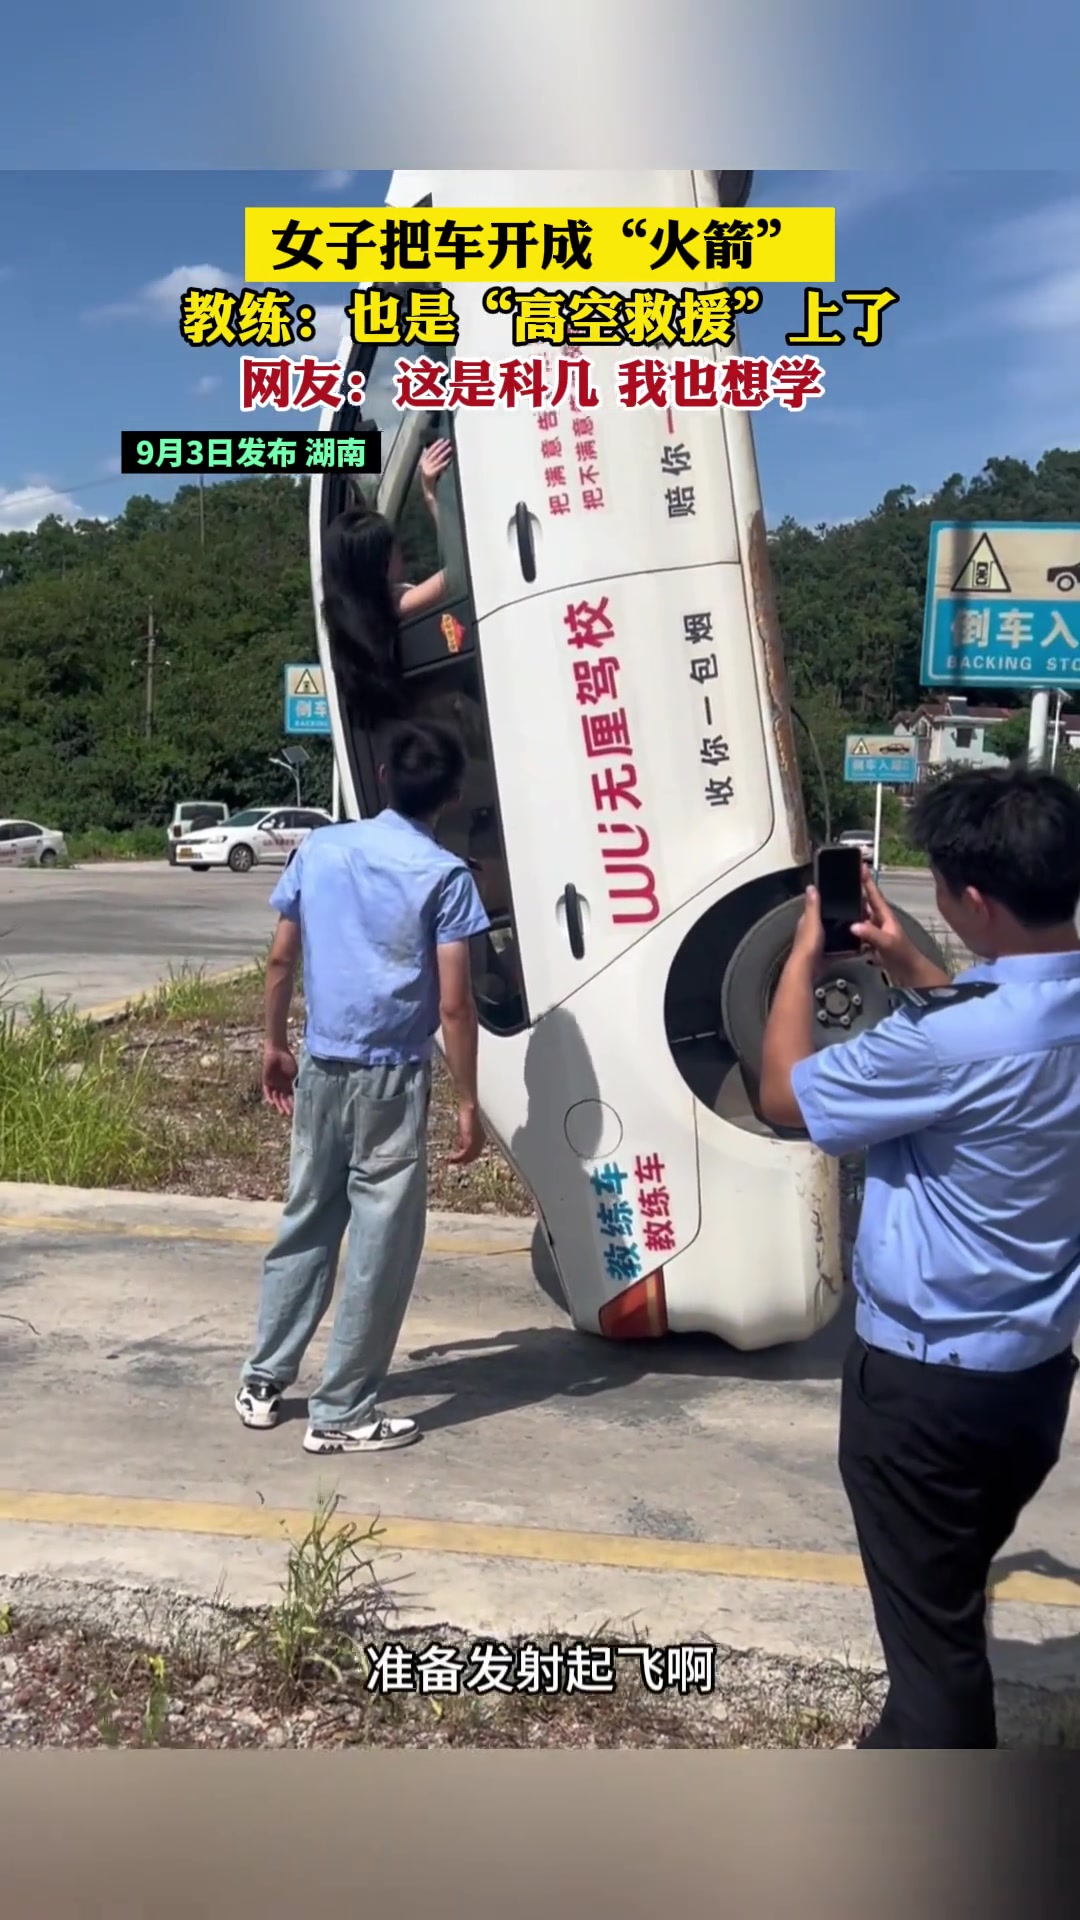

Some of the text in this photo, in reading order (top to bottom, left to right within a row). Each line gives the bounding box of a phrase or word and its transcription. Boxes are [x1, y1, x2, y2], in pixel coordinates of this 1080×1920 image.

[946, 655, 1032, 672] BACKING
[951, 607, 1079, 649] 倒车入
[563, 596, 643, 812] 无厘驾校
[683, 611, 736, 807] 收你一包烟
[590, 1162, 643, 1281] 教练车
[633, 1152, 677, 1252] 教练车
